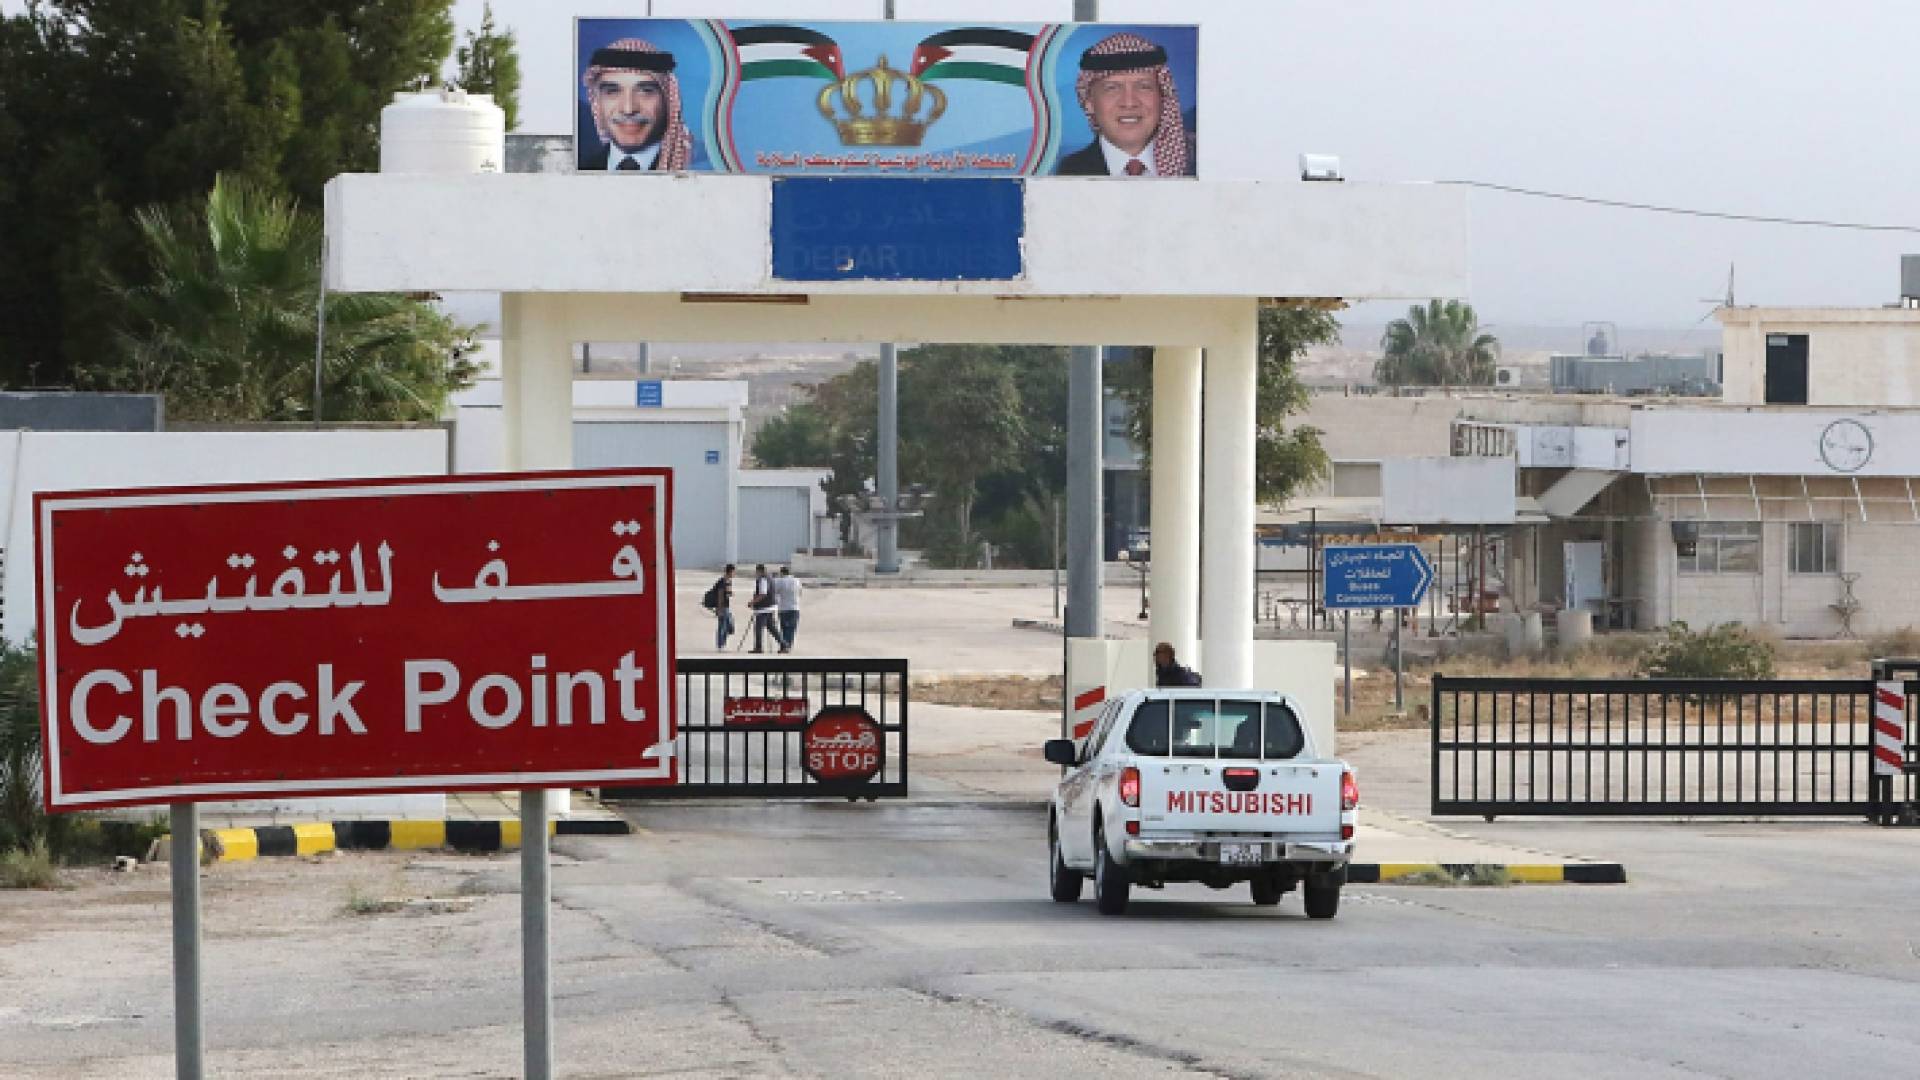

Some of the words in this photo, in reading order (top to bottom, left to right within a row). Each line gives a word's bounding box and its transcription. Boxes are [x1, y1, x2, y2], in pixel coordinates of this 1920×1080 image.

[70, 539, 394, 646] للتفتيش
[433, 520, 646, 603] قف
[69, 663, 368, 744] Check
[404, 651, 646, 732] Point
[809, 752, 877, 771] STOP
[1166, 790, 1313, 816] MITSUBISHI
